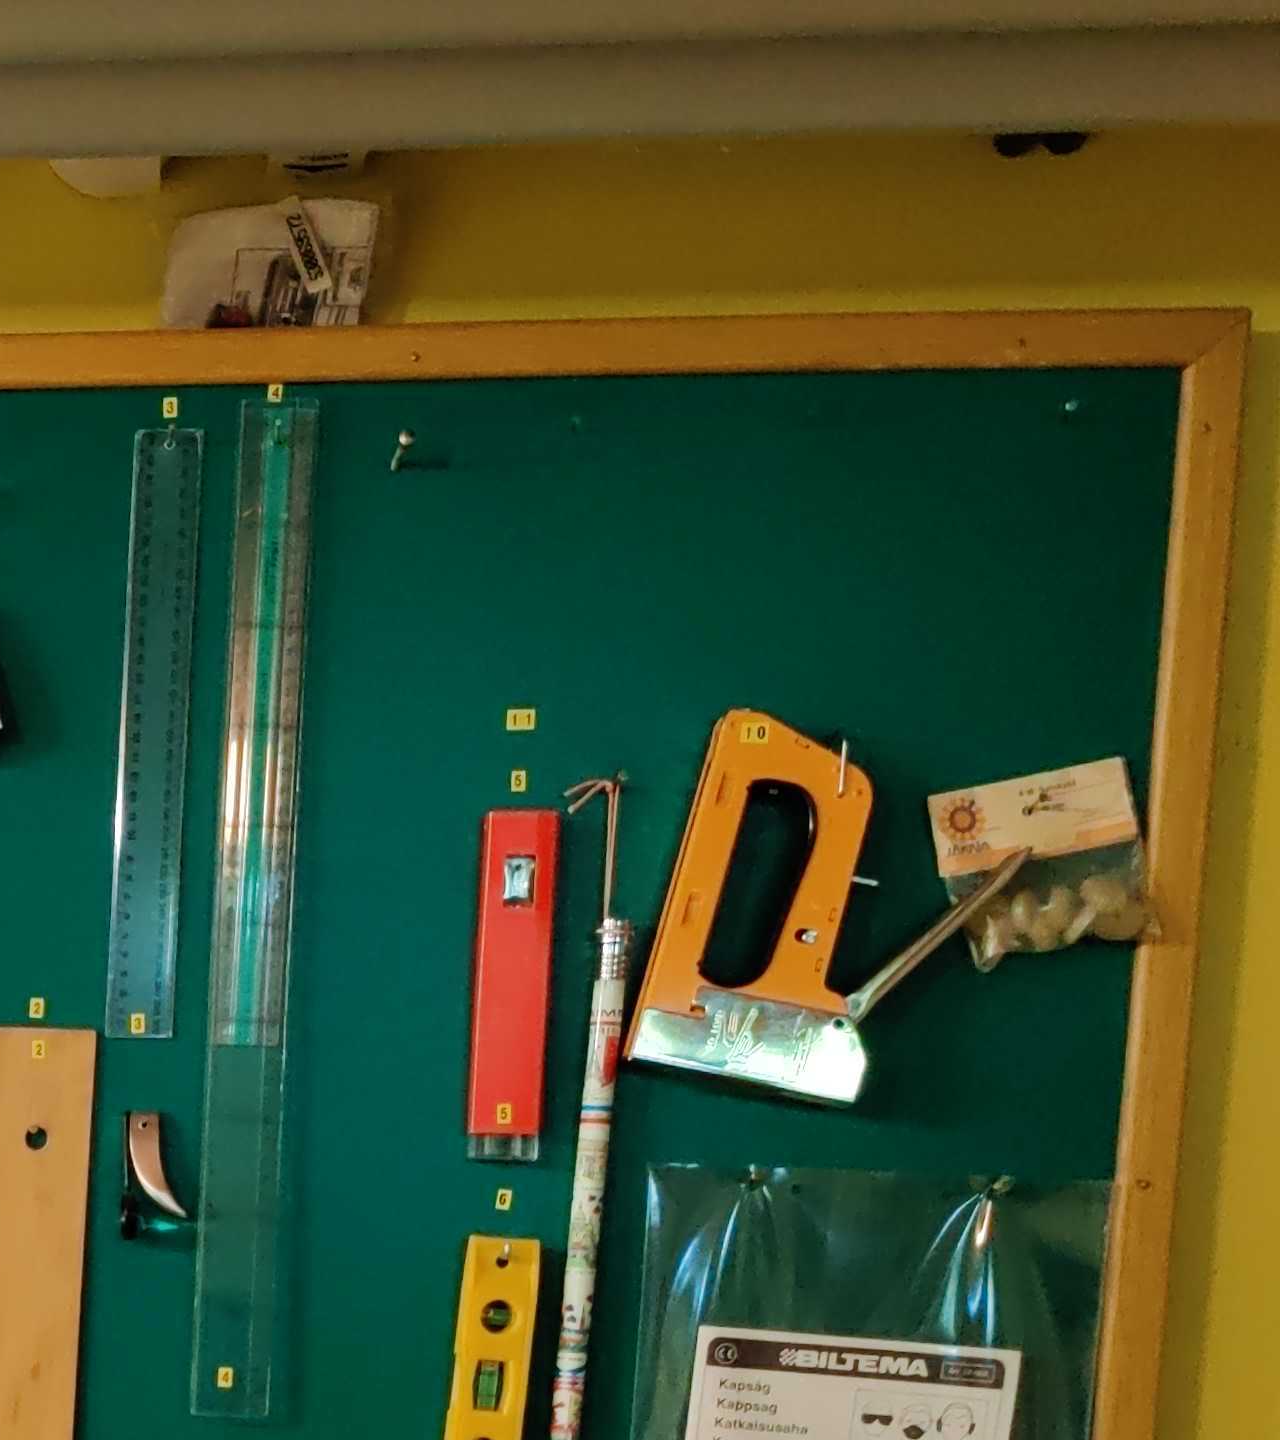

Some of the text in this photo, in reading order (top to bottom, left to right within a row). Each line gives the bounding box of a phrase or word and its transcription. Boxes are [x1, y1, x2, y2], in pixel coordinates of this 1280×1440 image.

[272, 387, 280, 399] 4
[167, 401, 174, 414] 3
[746, 726, 765, 740] 10
[515, 774, 522, 787] 5
[33, 1002, 41, 1015] 2
[134, 1017, 141, 1029] 3
[35, 1044, 42, 1056] 2
[501, 1107, 508, 1120] 5
[499, 1193, 506, 1206] 6
[797, 1349, 929, 1378] BILTEMA
[222, 1372, 229, 1383] 4
